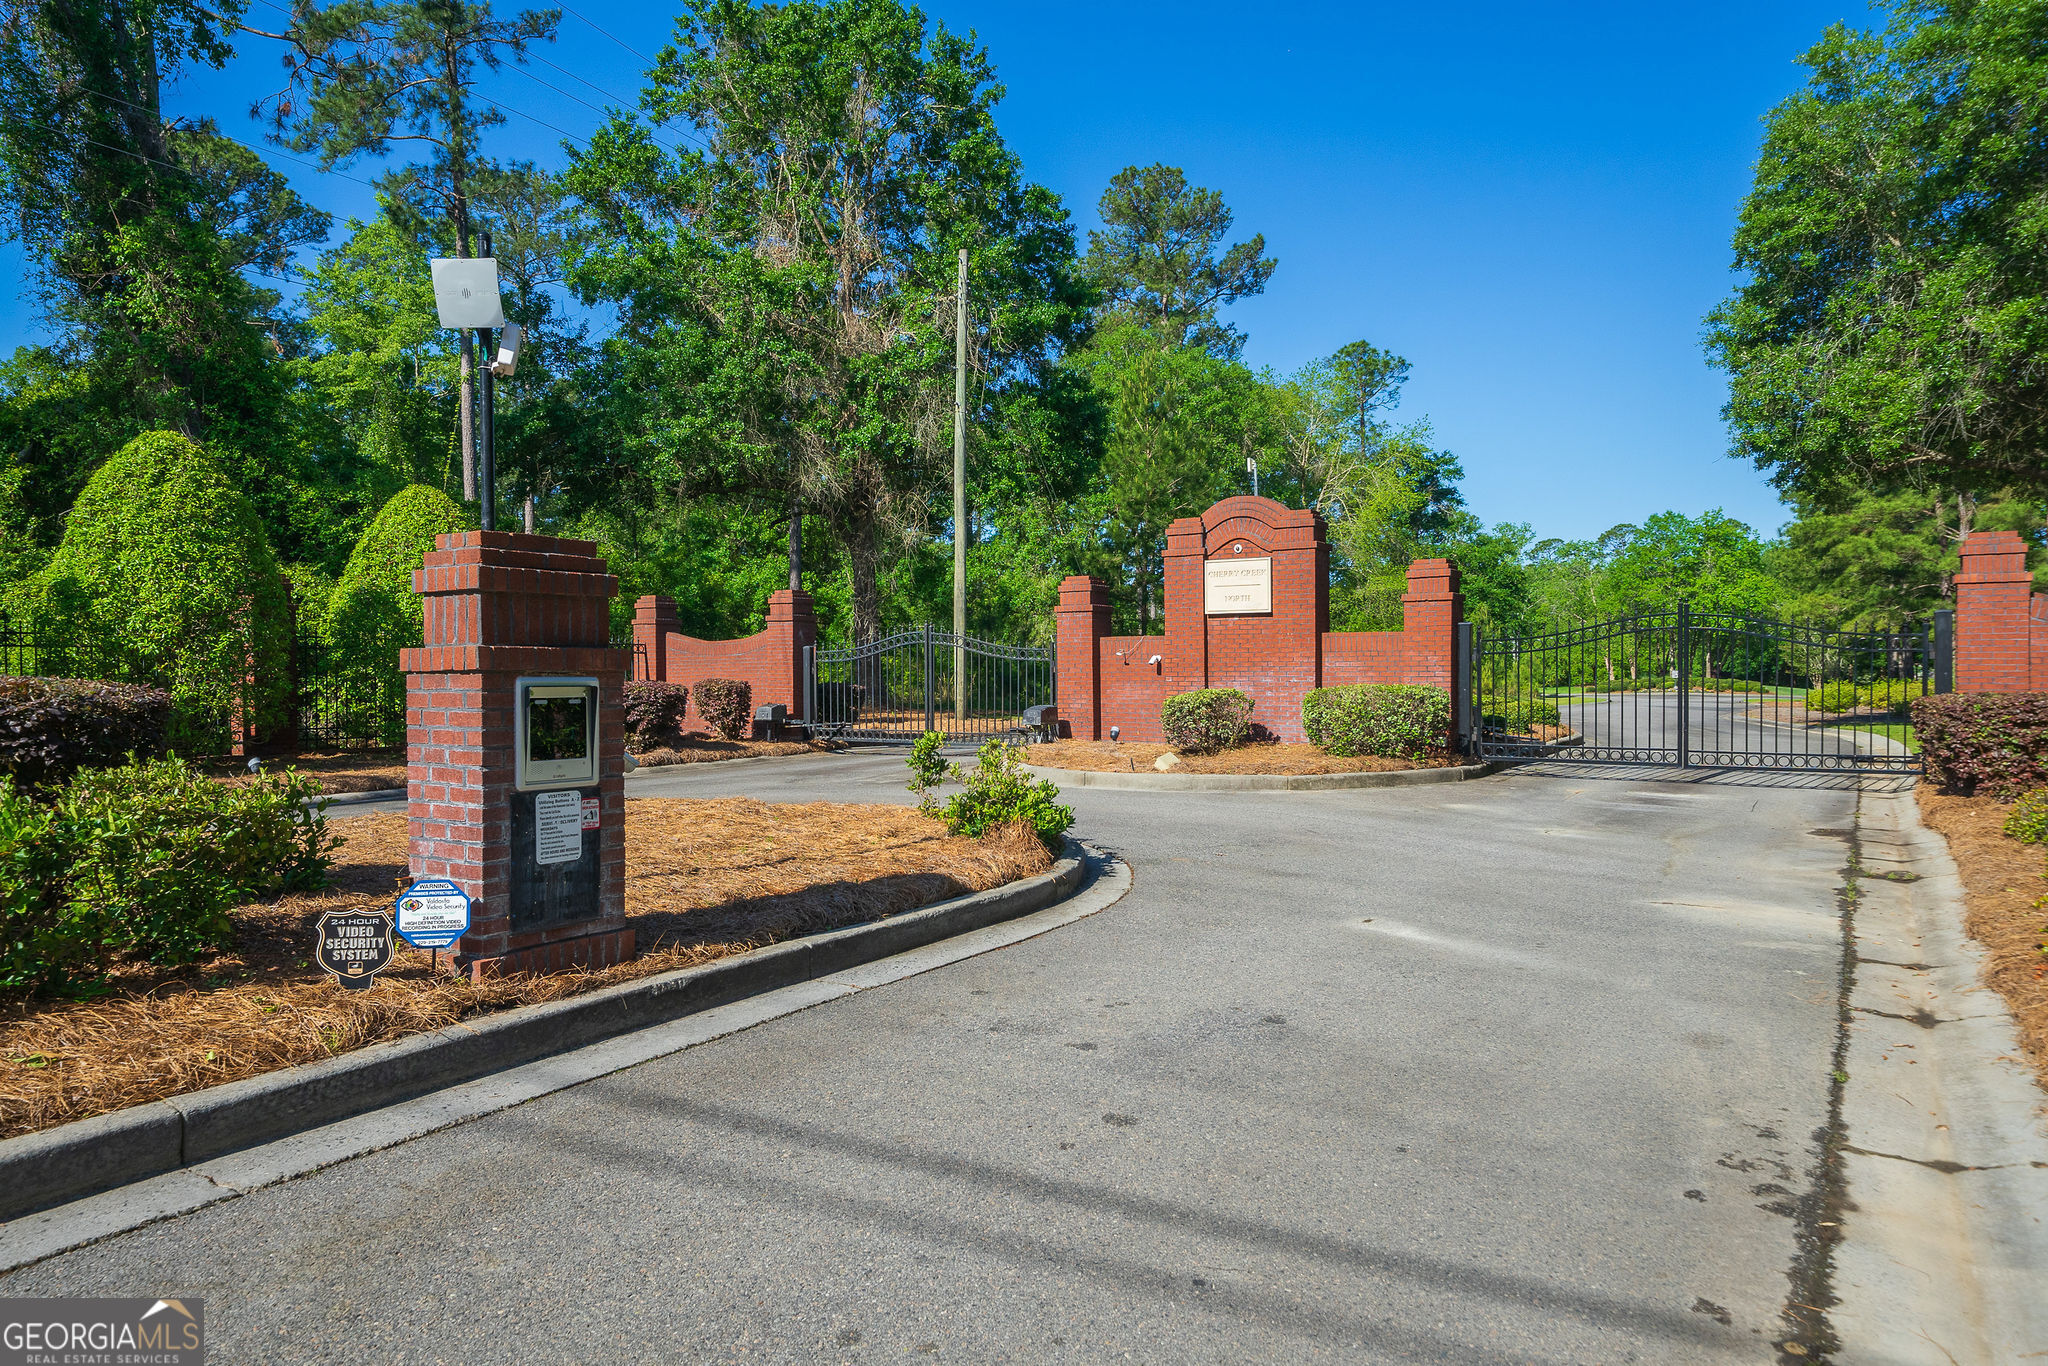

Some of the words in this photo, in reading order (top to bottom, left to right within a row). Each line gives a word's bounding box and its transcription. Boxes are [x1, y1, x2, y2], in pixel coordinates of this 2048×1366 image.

[1208, 570, 1240, 578] CHERRY
[1241, 568, 1267, 577] CREEK
[1224, 594, 1251, 602] NORTH
[444, 903, 466, 911] Security
[337, 926, 374, 938] VIDEO
[325, 937, 385, 950] SECURITY
[332, 949, 379, 961] SYSTEM
